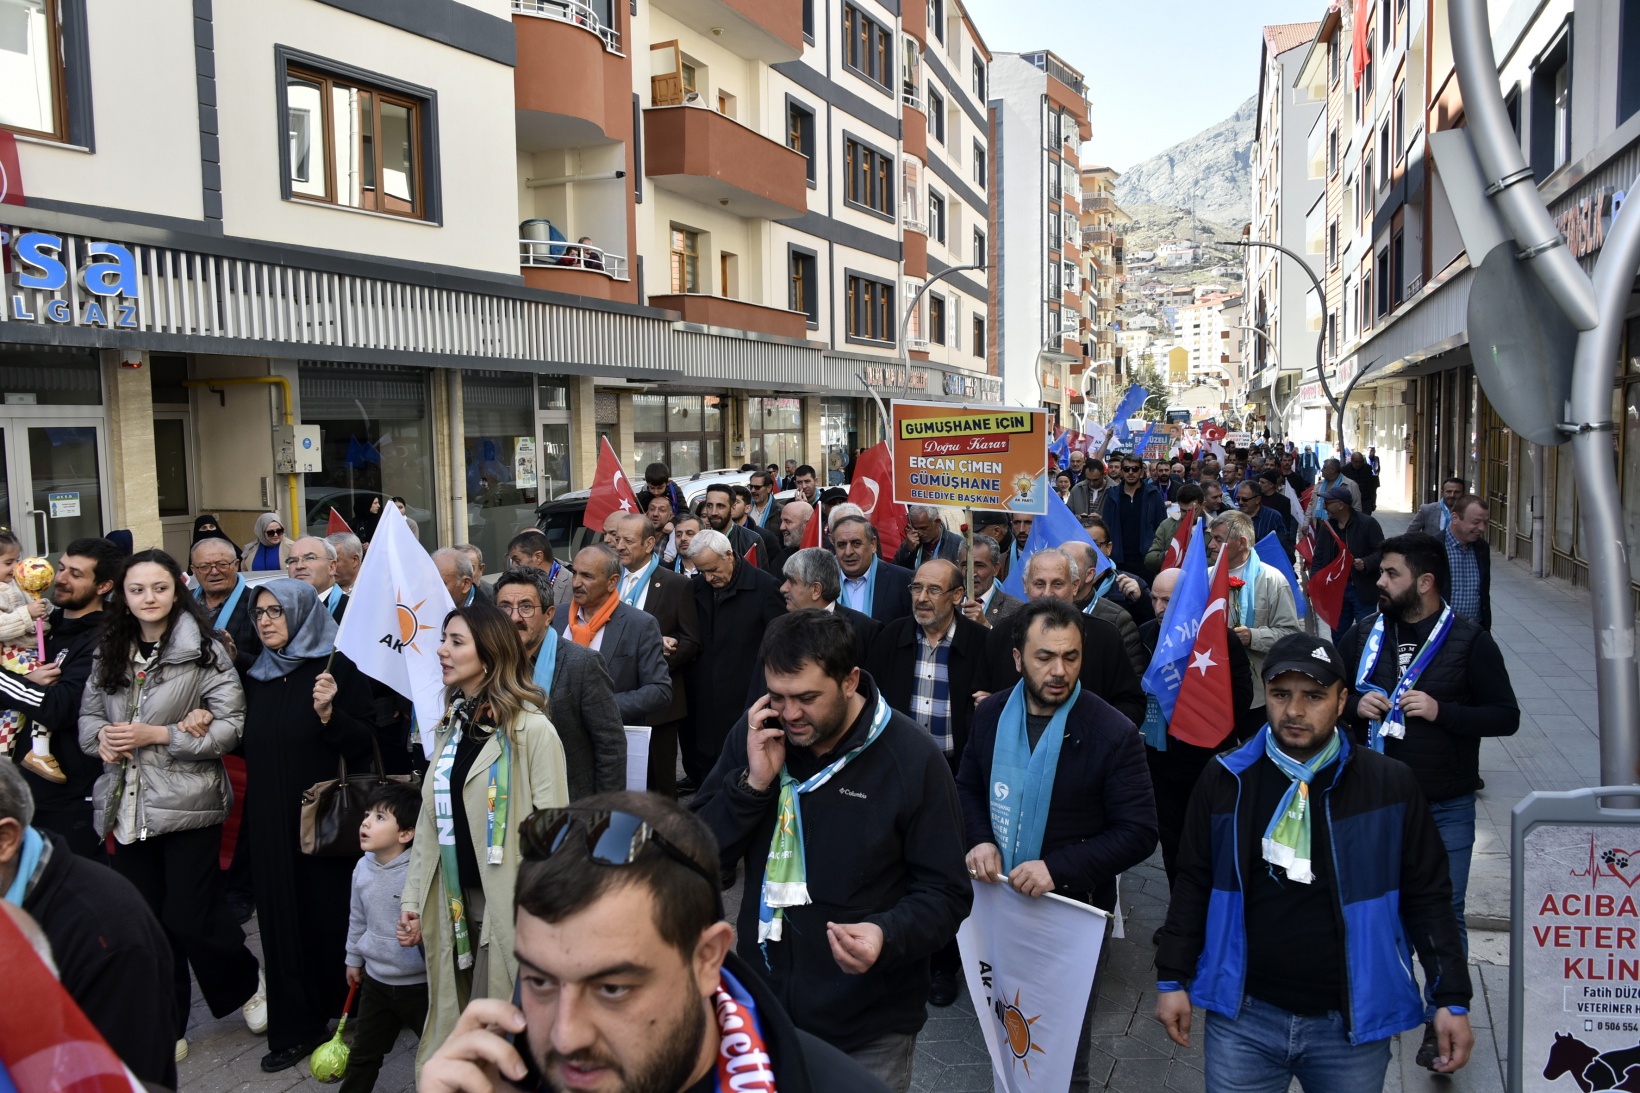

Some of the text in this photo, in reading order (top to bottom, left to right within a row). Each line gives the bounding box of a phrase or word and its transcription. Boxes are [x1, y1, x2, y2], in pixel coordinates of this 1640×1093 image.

[905, 416, 1025, 434] GÜMÜŞHANE İÇİN
[923, 437, 1007, 455] Doğru Karar
[1149, 435, 1168, 444] ÜZELİ
[909, 456, 1002, 474] ERCAN ÇİMEN
[910, 471, 1000, 491] GÜMÜŞHANE
[911, 489, 1000, 504] BELEDİYE BAŞKANI
[379, 634, 404, 654] AK
[845, 789, 867, 799] Columbia
[1538, 893, 1639, 918] ACIBA
[1532, 925, 1637, 949] VETER
[979, 960, 993, 989] AK
[1564, 953, 1639, 981] KLİN
[1583, 986, 1612, 998] Fatih
[1577, 1001, 1632, 1013] VETERİNER
[1597, 1021, 1639, 1032] 0 506 554
